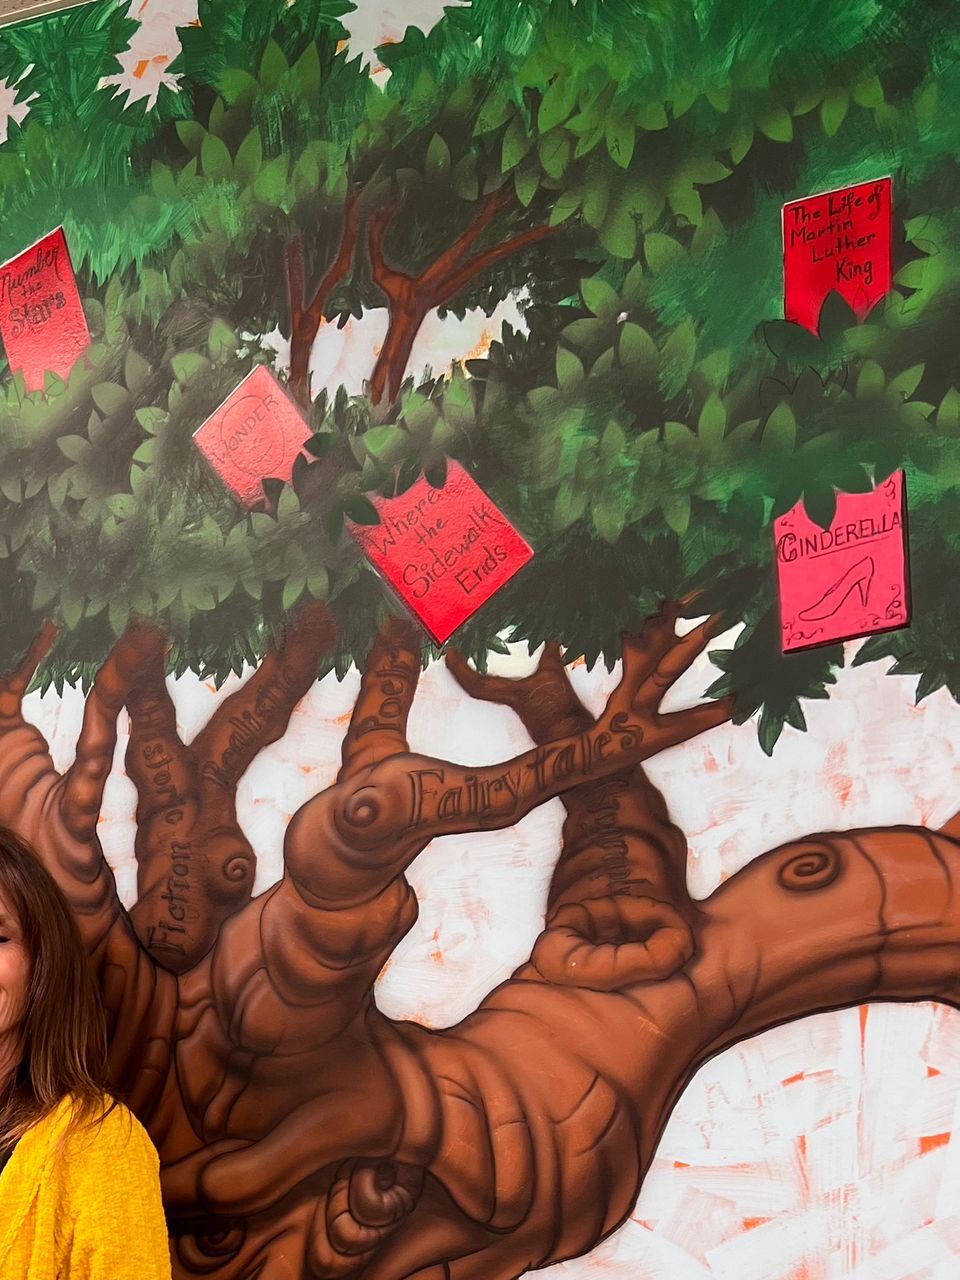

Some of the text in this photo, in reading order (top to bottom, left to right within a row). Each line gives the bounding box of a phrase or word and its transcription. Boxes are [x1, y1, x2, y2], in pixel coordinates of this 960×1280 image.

[788, 184, 885, 225] The Life of
[790, 219, 854, 248] Martin
[811, 233, 876, 264] Luther
[20, 281, 42, 298] the
[836, 257, 873, 285] King
[8, 291, 67, 339] Stars
[208, 394, 279, 465] WONDER
[368, 488, 441, 556] Where
[415, 517, 449, 546] the
[777, 511, 903, 564] CINDERELLA
[402, 502, 511, 599] Sidewalk
[454, 544, 508, 596] Ends
